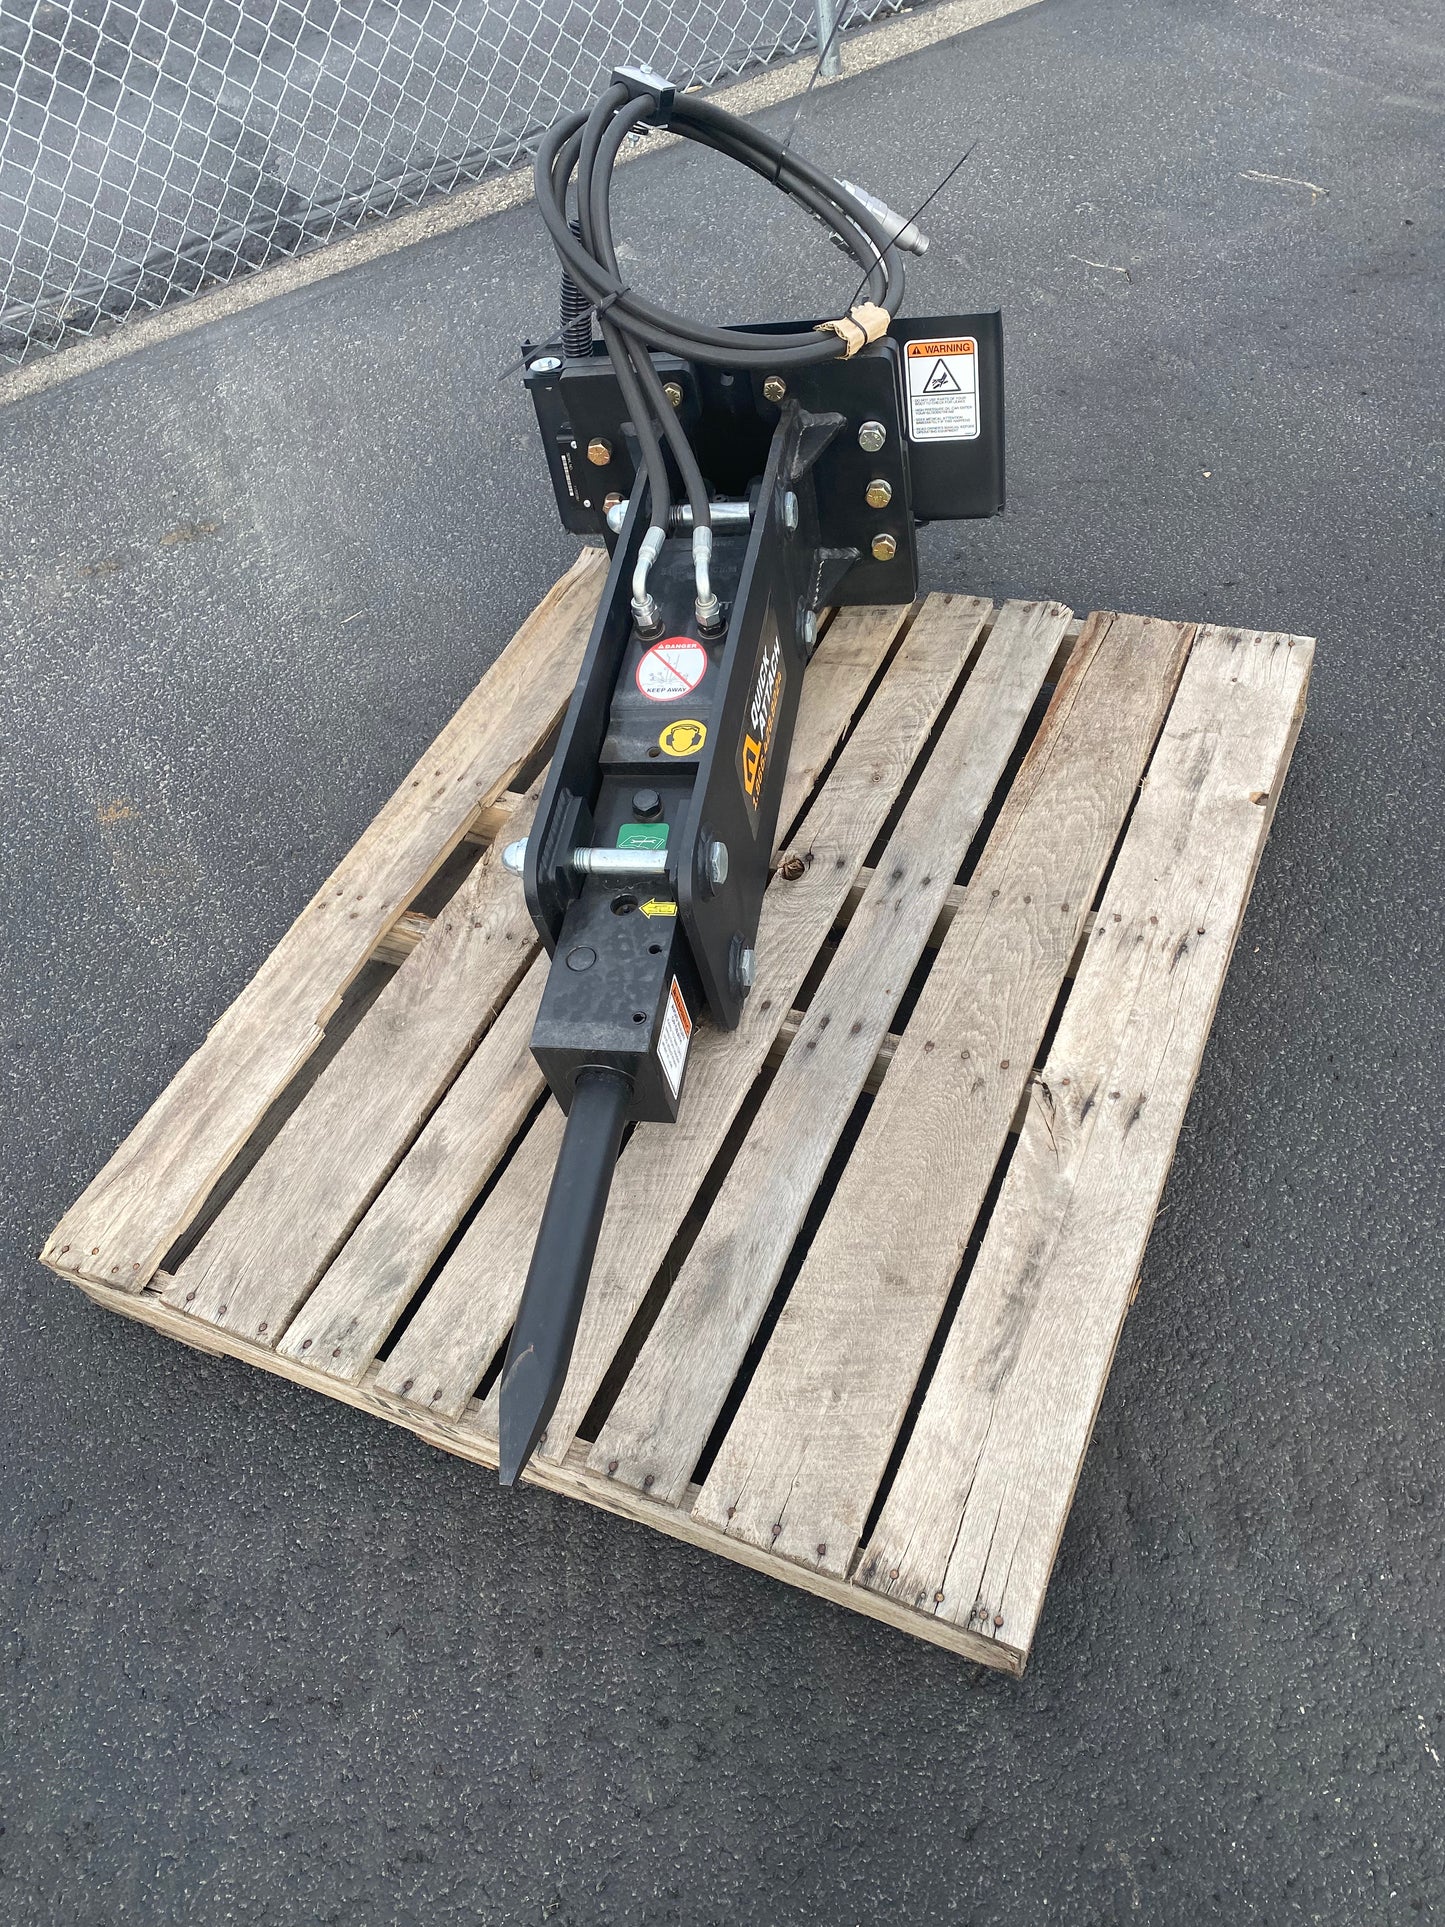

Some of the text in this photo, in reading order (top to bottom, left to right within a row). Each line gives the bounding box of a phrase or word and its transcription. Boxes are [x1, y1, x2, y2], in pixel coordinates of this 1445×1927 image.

[925, 343, 970, 354] WARNING
[751, 644, 770, 730] QUICK
[758, 635, 780, 740] ATTACH
